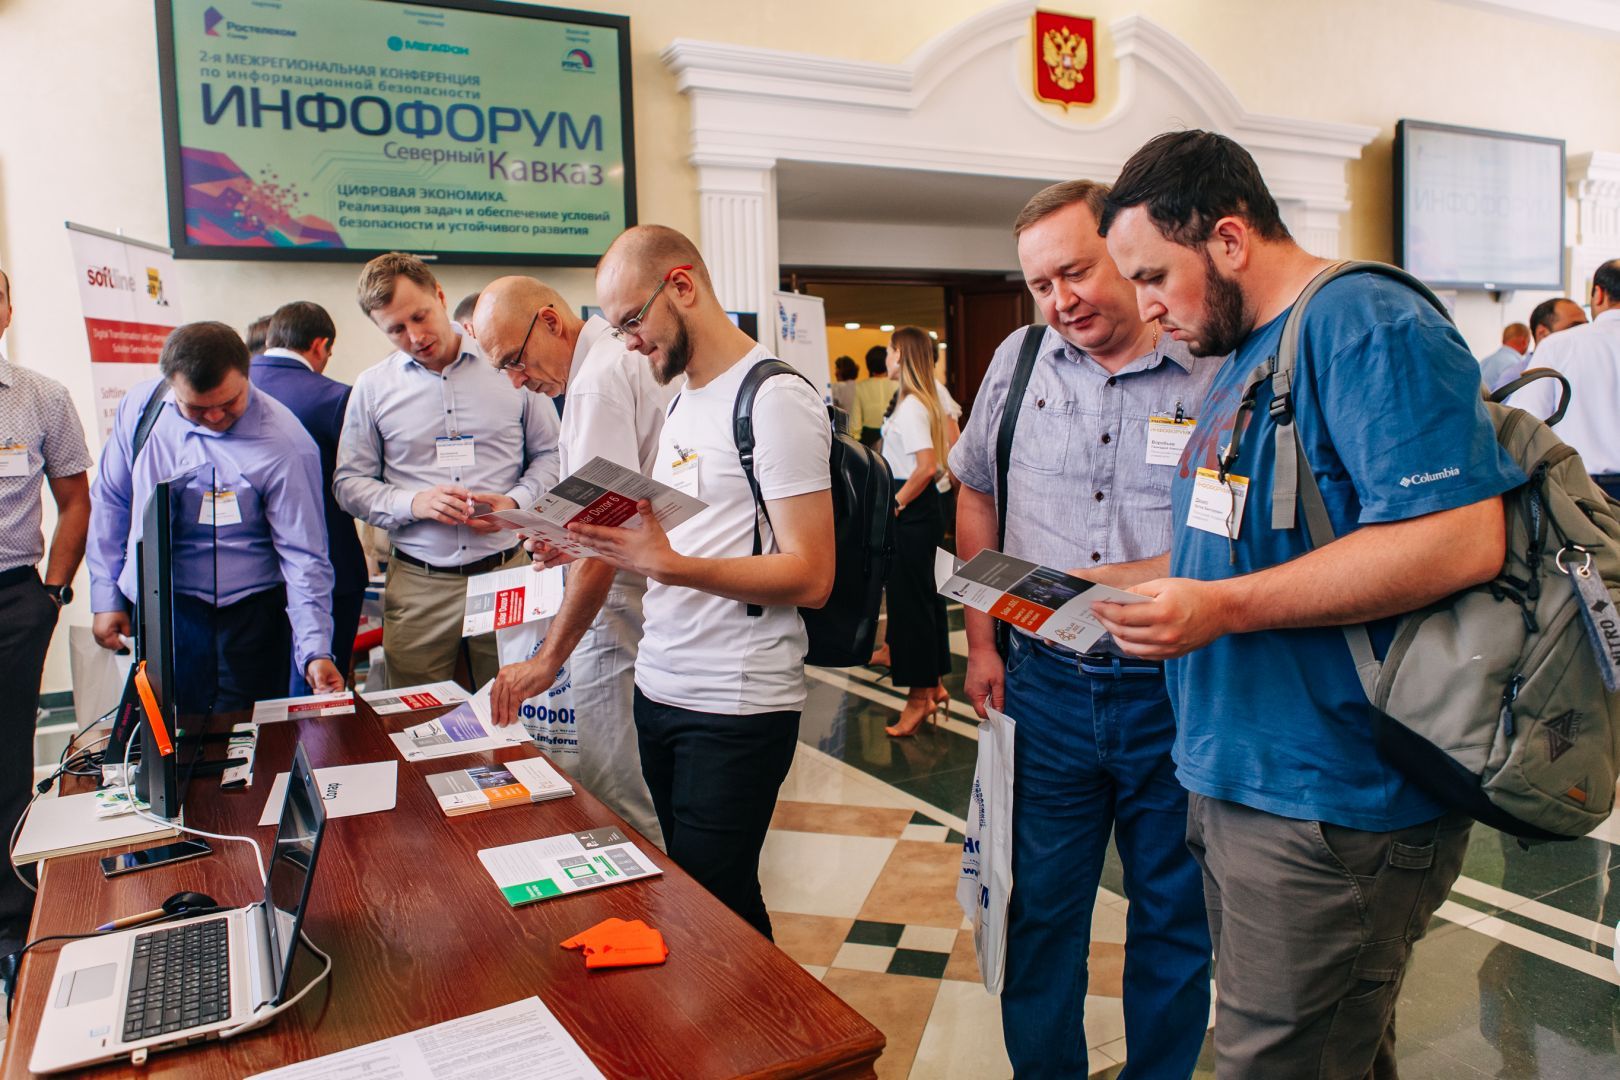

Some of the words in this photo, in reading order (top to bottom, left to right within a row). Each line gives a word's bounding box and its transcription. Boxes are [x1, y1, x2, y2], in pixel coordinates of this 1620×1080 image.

[226, 21, 297, 37] Ростелеком
[200, 50, 222, 63] 2-я
[225, 53, 376, 77] МЕЖРЕГИОНАЛЬНАЯ
[380, 67, 481, 86] КОНФЕРЕНЦИЯ
[200, 67, 221, 78] по
[226, 70, 373, 91] информационной
[378, 80, 481, 99] безопасности
[201, 83, 604, 151] ИНФОФОРУМ
[383, 141, 485, 165] Северный
[488, 150, 604, 186] Кавказ
[337, 184, 416, 198] ЦИФРОВАЯ
[338, 200, 421, 215] Реализация
[424, 206, 462, 217] задач
[465, 208, 474, 216] и
[477, 206, 559, 219] обеспечение
[561, 211, 611, 223] условий
[339, 216, 434, 231] безопасности
[437, 221, 446, 231] и
[448, 221, 530, 234] устойчивого
[532, 225, 589, 236] развития
[1411, 467, 1460, 485] Columbia
[588, 500, 615, 516] Dozor
[549, 681, 571, 698] ФОРУ
